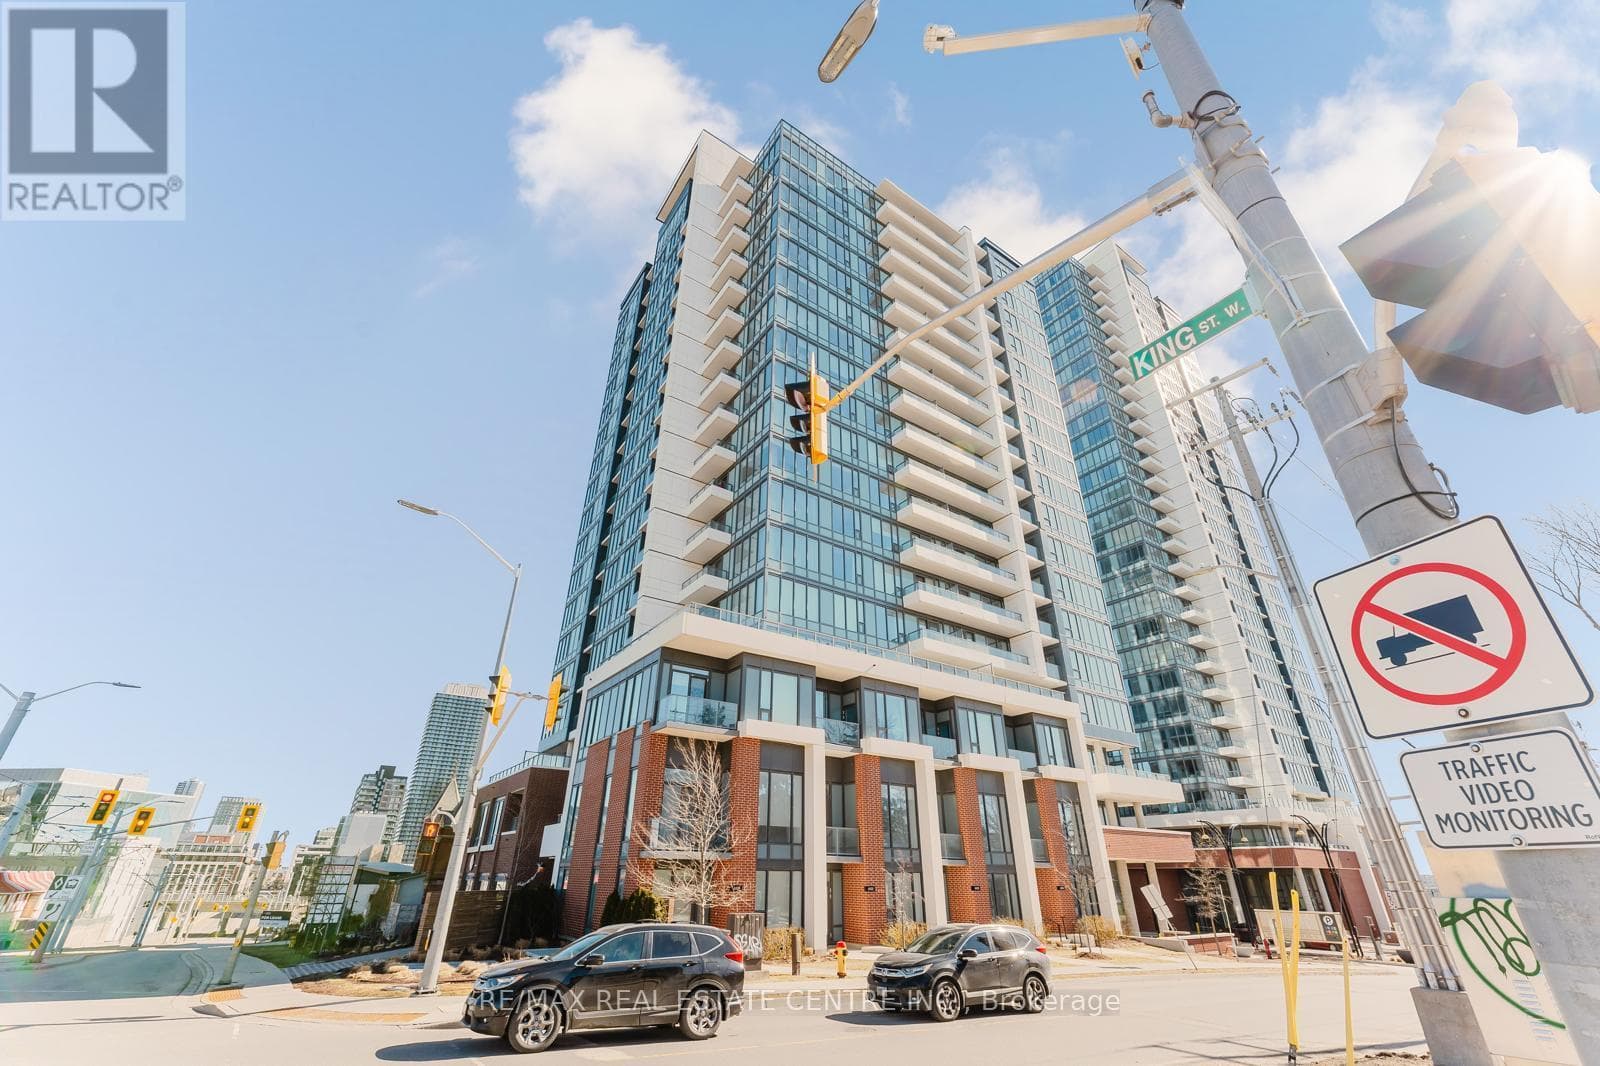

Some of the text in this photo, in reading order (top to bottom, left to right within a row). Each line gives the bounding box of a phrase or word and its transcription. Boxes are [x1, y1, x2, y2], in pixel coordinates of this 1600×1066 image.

[1133, 302, 1245, 378] KING ST. W.
[1438, 751, 1536, 781] TRAFFIC
[1459, 779, 1535, 805] VIDEO
[1434, 803, 1593, 834] MONITORING
